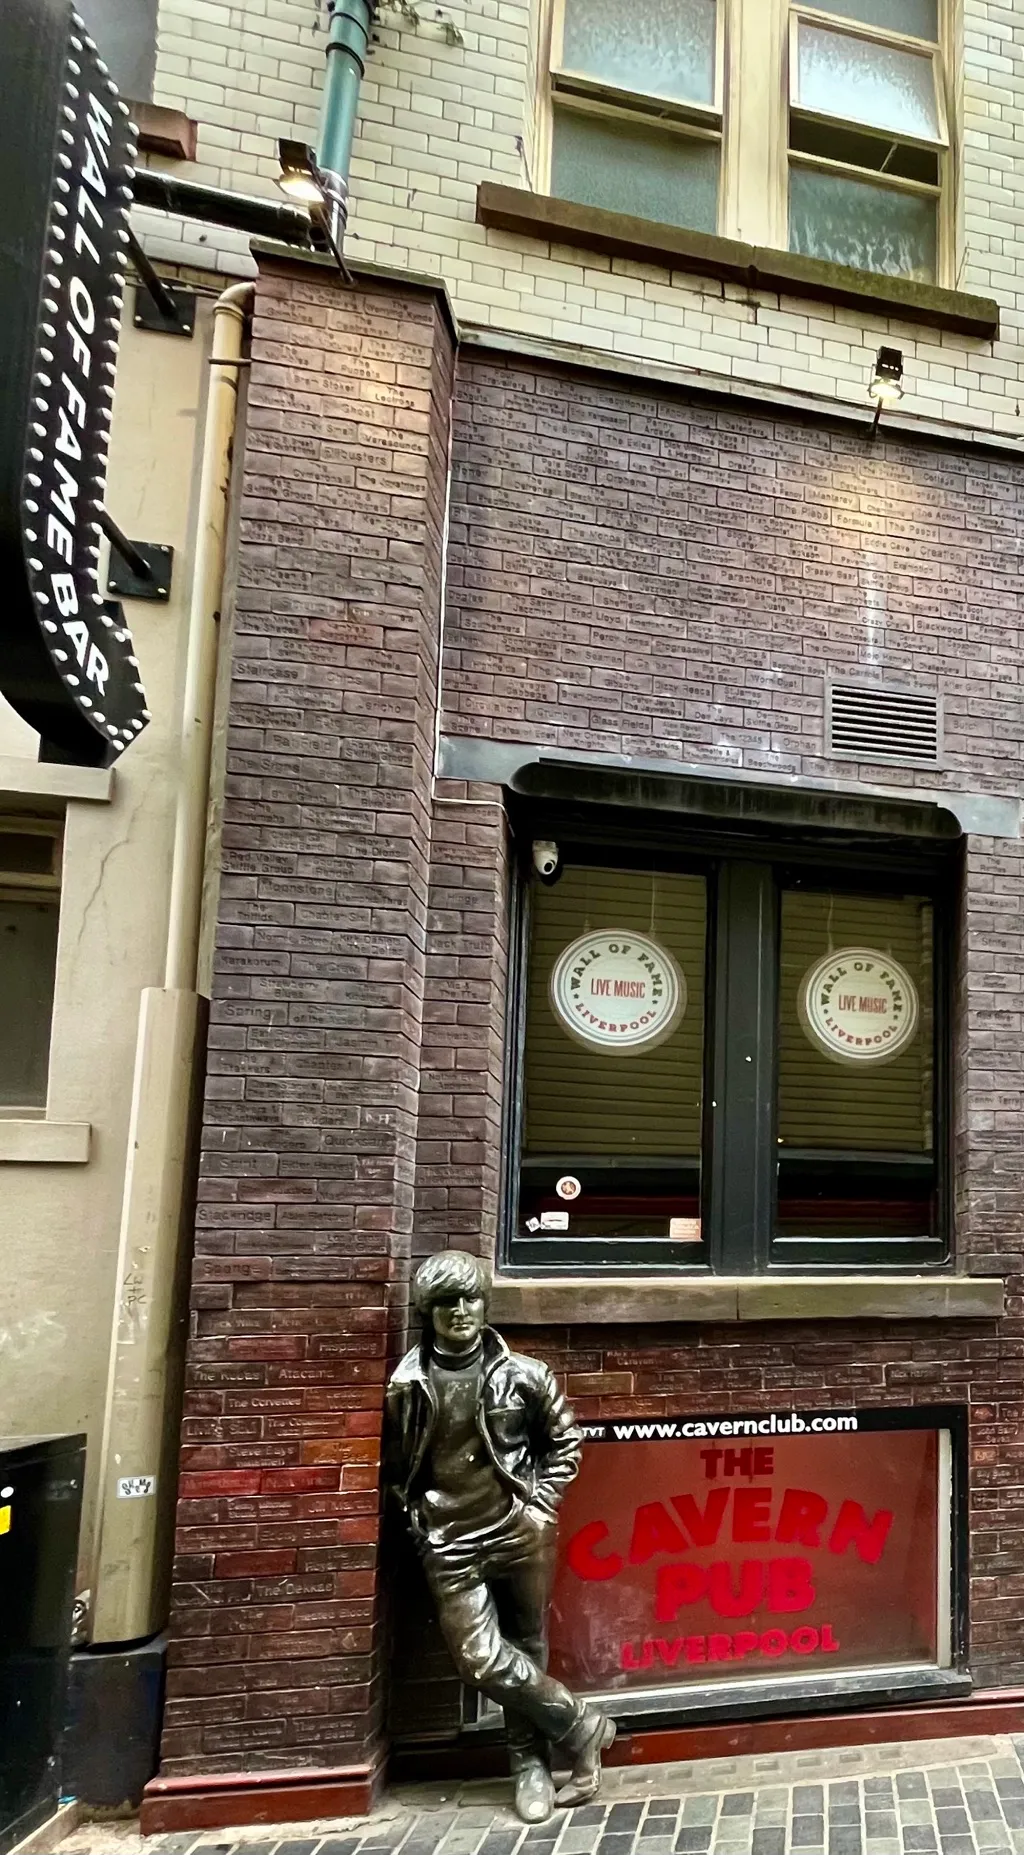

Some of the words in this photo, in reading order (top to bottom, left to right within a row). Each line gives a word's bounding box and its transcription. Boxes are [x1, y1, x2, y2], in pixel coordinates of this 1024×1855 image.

[74, 92, 113, 264] WALL
[66, 276, 95, 379] OF
[47, 372, 87, 566] FAME
[780, 504, 796, 515] The
[837, 514, 872, 528] Formula
[889, 522, 905, 532] The
[920, 546, 960, 560] Creation
[722, 570, 772, 586] Parachute
[571, 608, 592, 619] Fred
[917, 621, 963, 634] Blackwood
[50, 572, 109, 697] BAR
[592, 715, 618, 726] Glass
[622, 719, 649, 730] Fields
[570, 949, 601, 990] WALL
[608, 943, 631, 955] OF
[637, 952, 662, 997] FAME
[590, 978, 612, 996] LIVE
[613, 980, 646, 999] MUSIC
[820, 967, 848, 1006] WALL
[853, 962, 875, 973] OF
[879, 971, 903, 1013] FAME
[575, 1002, 657, 1033] LIVERPOOL
[838, 994, 856, 1012] LIVE
[859, 995, 888, 1014] MUSIC
[825, 1017, 897, 1046] LIVERPOOL
[612, 1413, 859, 1440] www.cavernclub.com
[1002, 1408, 1019, 1417] The
[699, 1446, 775, 1480] THE
[566, 1486, 895, 1582] CAVERN
[654, 1557, 816, 1624] PUB
[620, 1624, 841, 1672] LIVERPOOL
